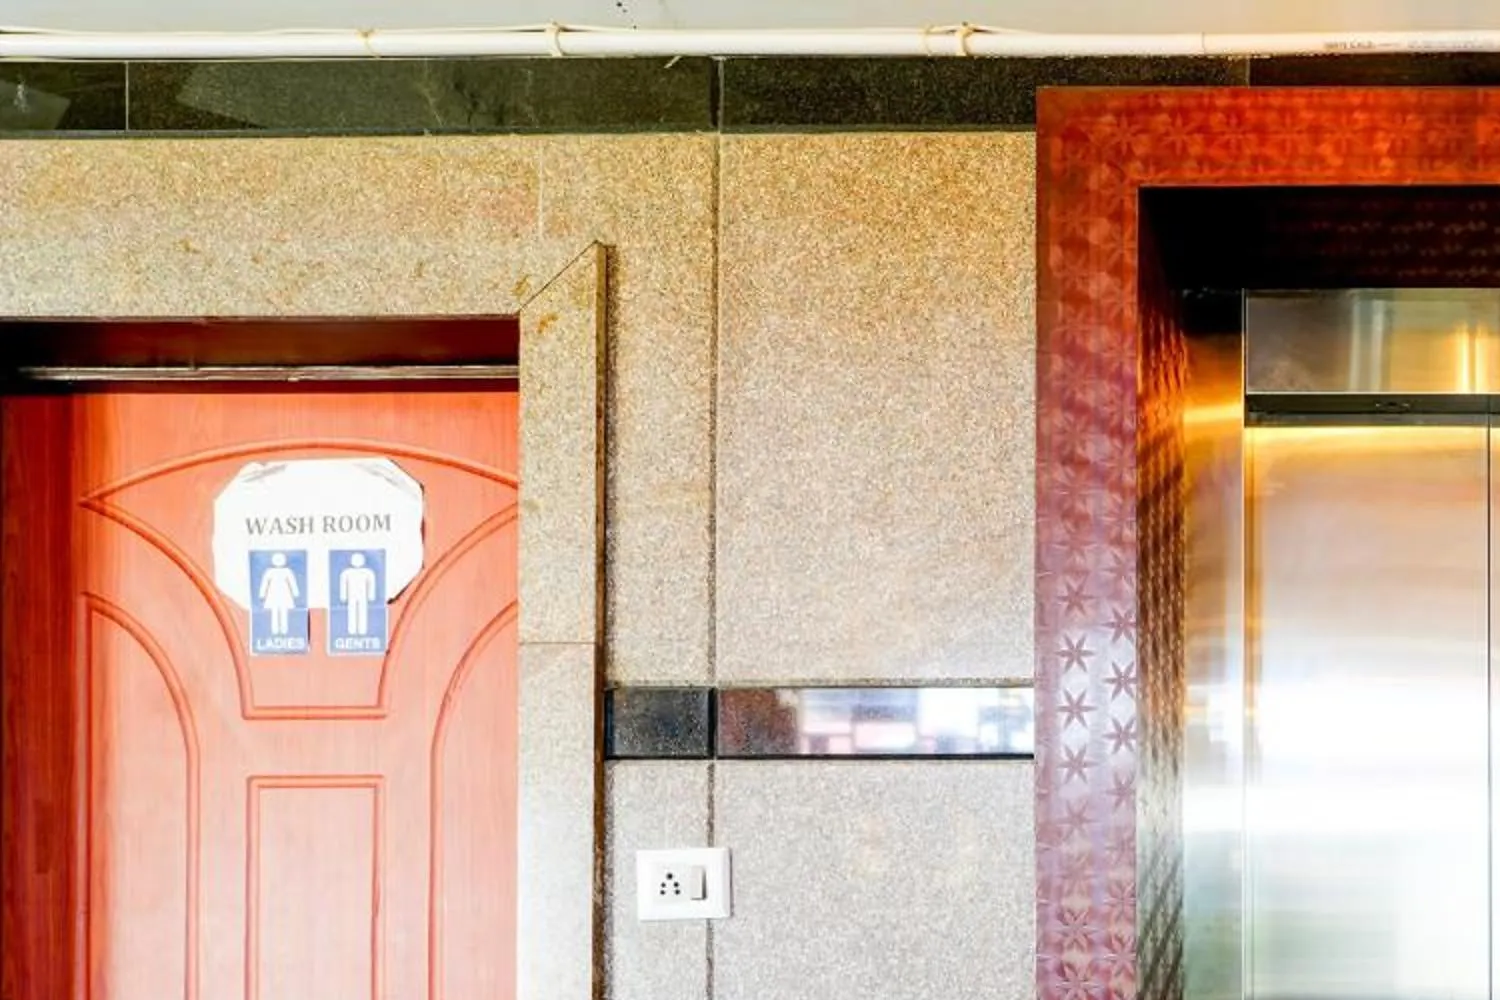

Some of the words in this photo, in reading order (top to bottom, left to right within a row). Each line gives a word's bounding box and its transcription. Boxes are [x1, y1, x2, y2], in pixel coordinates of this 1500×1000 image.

[245, 516, 314, 535] WASH
[323, 513, 391, 533] ROOM
[257, 637, 305, 650] LADIES
[335, 637, 381, 650] GENTS
